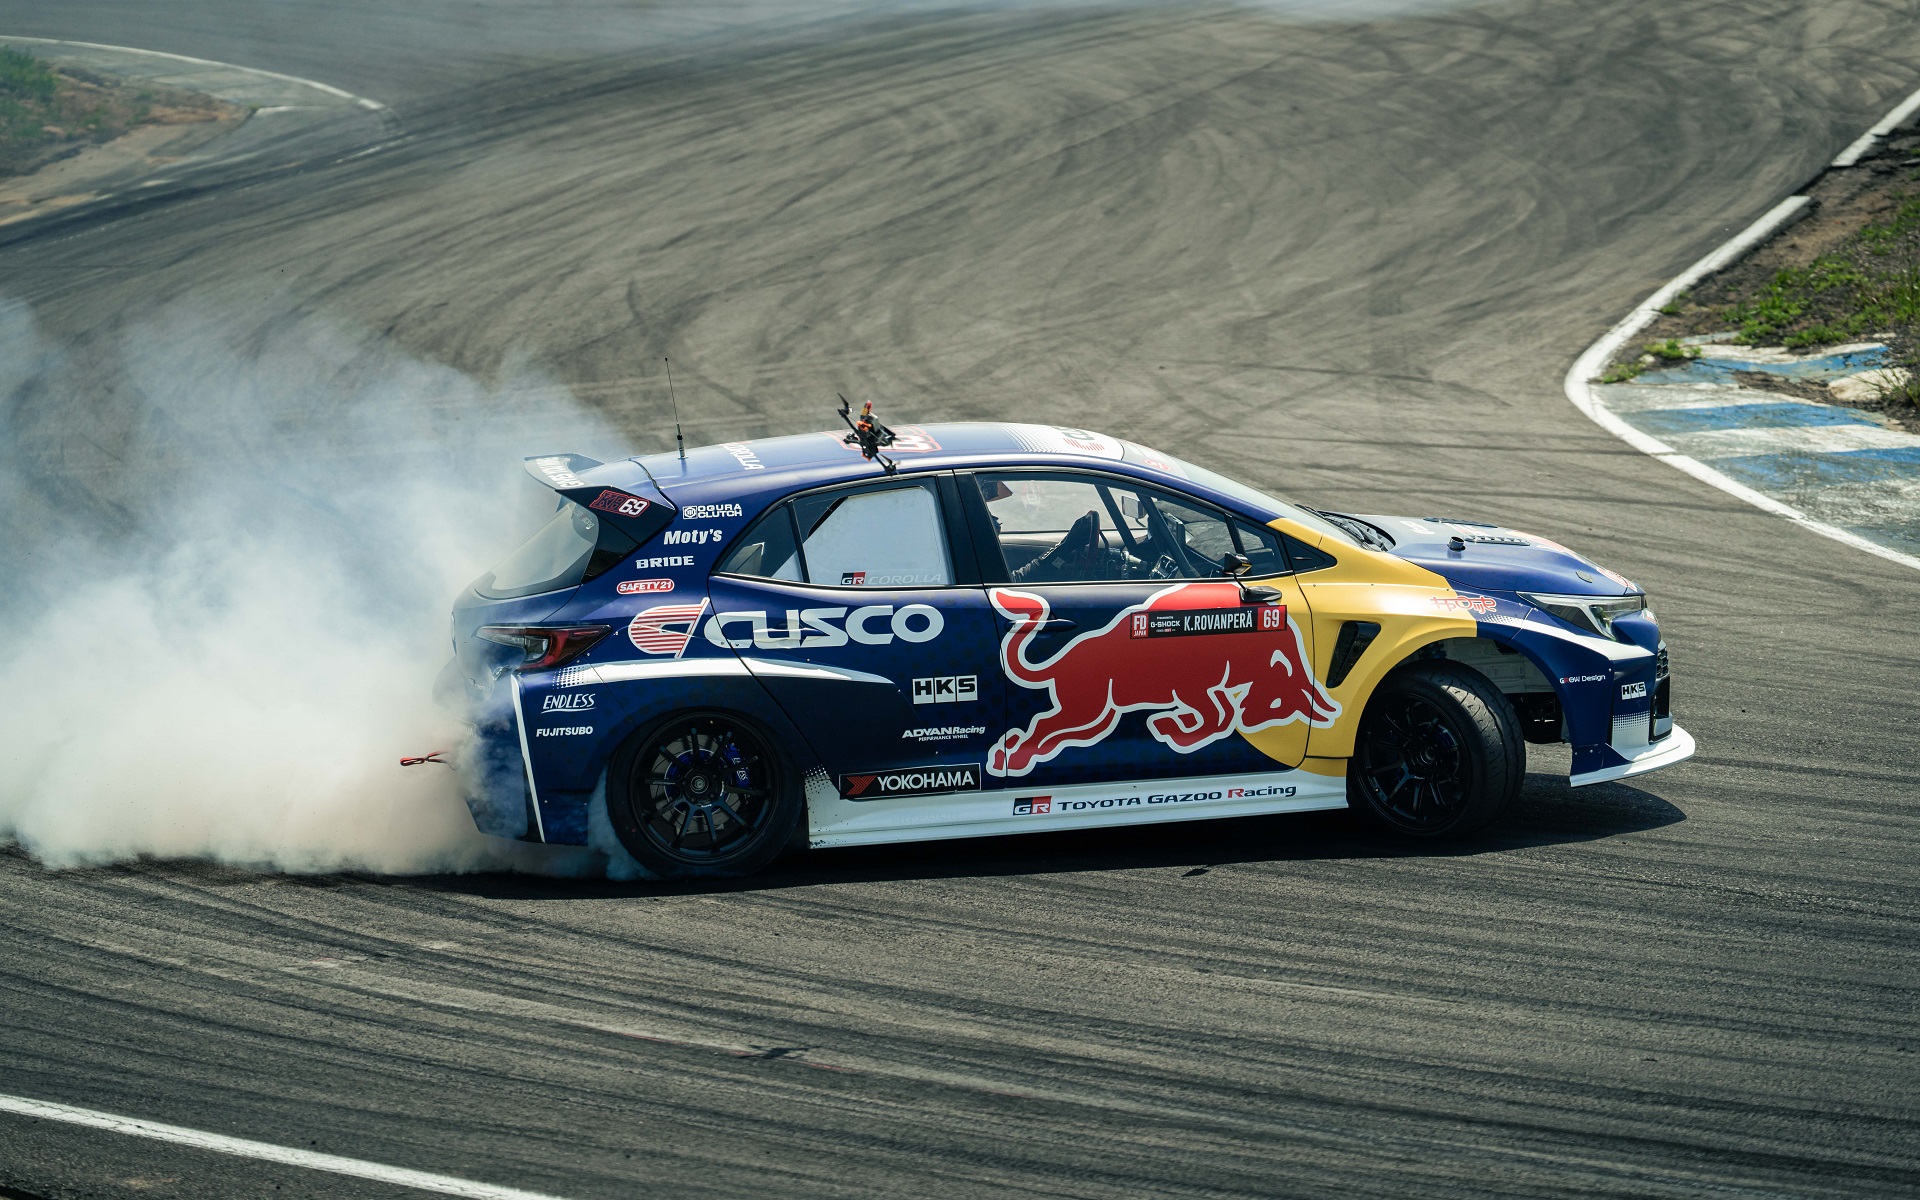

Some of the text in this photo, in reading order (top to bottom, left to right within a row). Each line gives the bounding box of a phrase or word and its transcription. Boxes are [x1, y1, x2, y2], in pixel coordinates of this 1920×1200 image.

[697, 503, 742, 512] OGURA
[697, 509, 743, 519] CLUTCH
[663, 528, 723, 546] Moty's
[635, 555, 695, 570] BRIDE
[867, 573, 942, 585] COROLLA
[703, 603, 945, 650] CUSCO
[1133, 614, 1147, 631] FD
[1150, 620, 1181, 628] G-SHOCK
[1263, 608, 1280, 629] 69
[1581, 674, 1606, 682] Design
[913, 677, 977, 696] HKS
[1622, 682, 1646, 697] HKS
[542, 692, 597, 711] ENDLESS
[535, 726, 594, 738] FUJITSUBO
[877, 770, 975, 791] YOKOHAMA
[1013, 785, 1297, 816] GR TOYOTA GAZOO Racing
